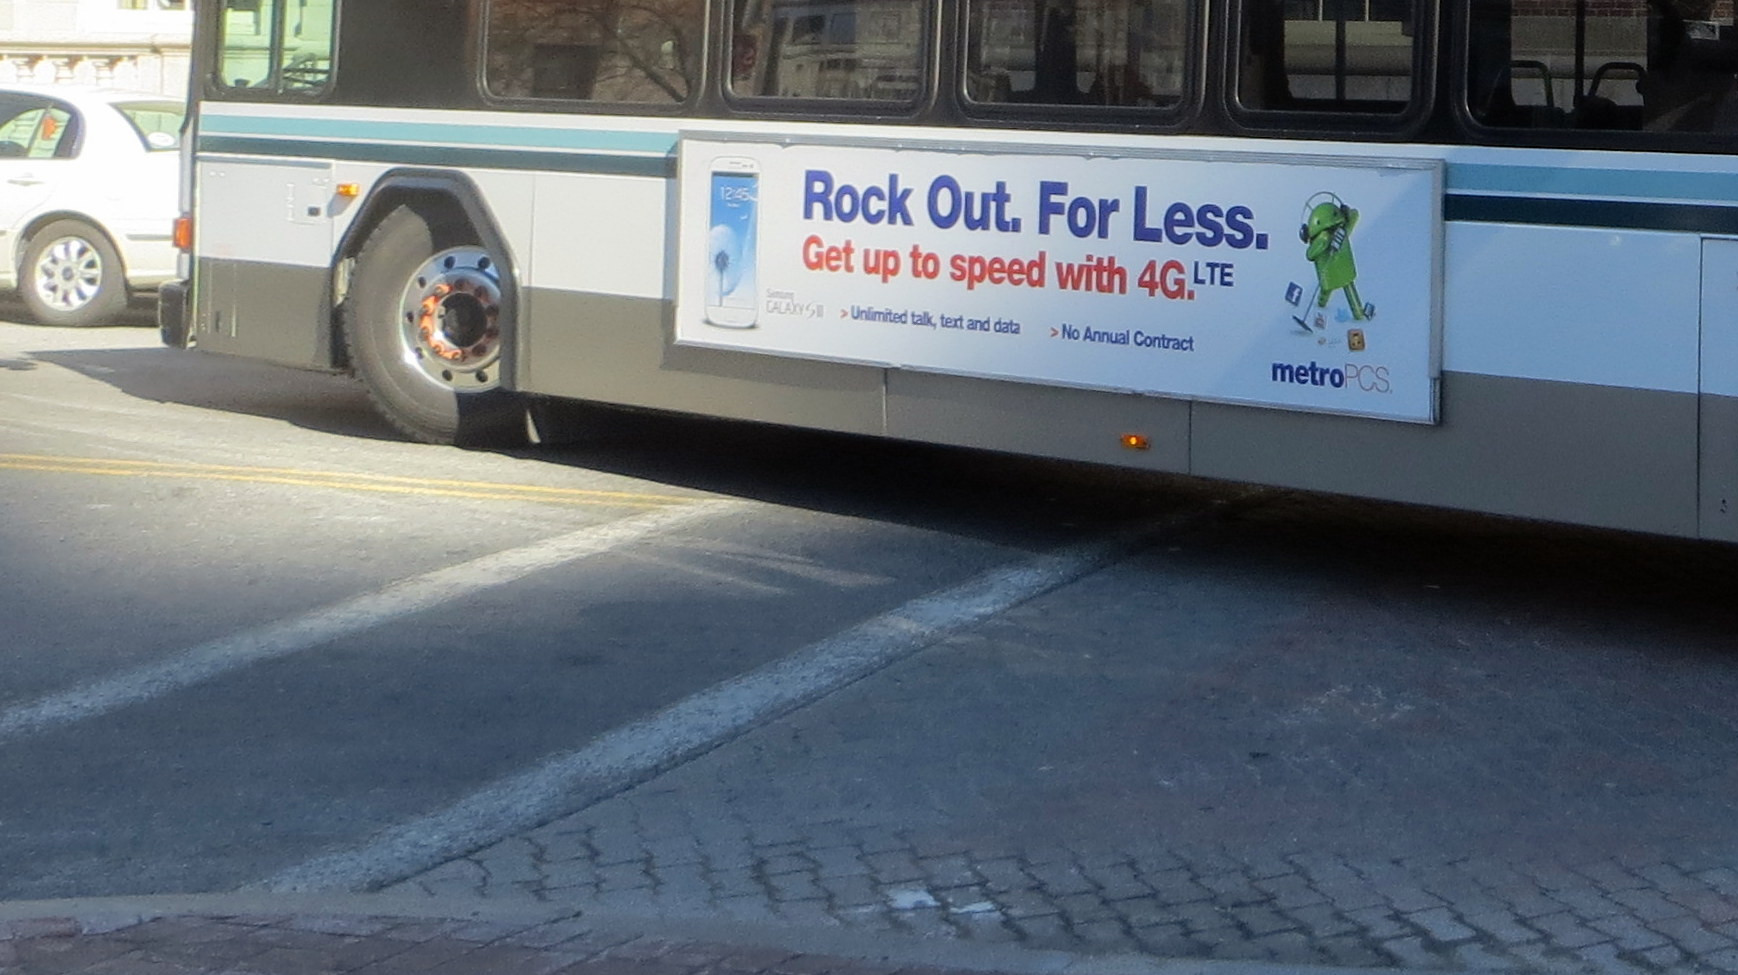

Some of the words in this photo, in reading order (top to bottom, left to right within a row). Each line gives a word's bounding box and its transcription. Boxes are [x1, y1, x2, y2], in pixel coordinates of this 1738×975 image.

[803, 169, 914, 226] Rock
[927, 174, 1022, 233] Out.
[1038, 180, 1119, 239] For
[1133, 186, 1268, 250] Less.
[802, 234, 855, 273] Get
[863, 248, 900, 283] up
[910, 244, 941, 279] to
[949, 251, 1046, 290] speed
[1055, 255, 1127, 295] with
[1193, 261, 1234, 287] LTE
[766, 299, 803, 317] GALAXY
[851, 305, 907, 325] Unlimited
[911, 310, 937, 330] talk,
[940, 315, 964, 330] text
[966, 317, 990, 333] and
[994, 319, 1020, 335] data
[1062, 324, 1080, 340] No
[1084, 326, 1129, 345] Annual
[1133, 331, 1195, 352] Contract
